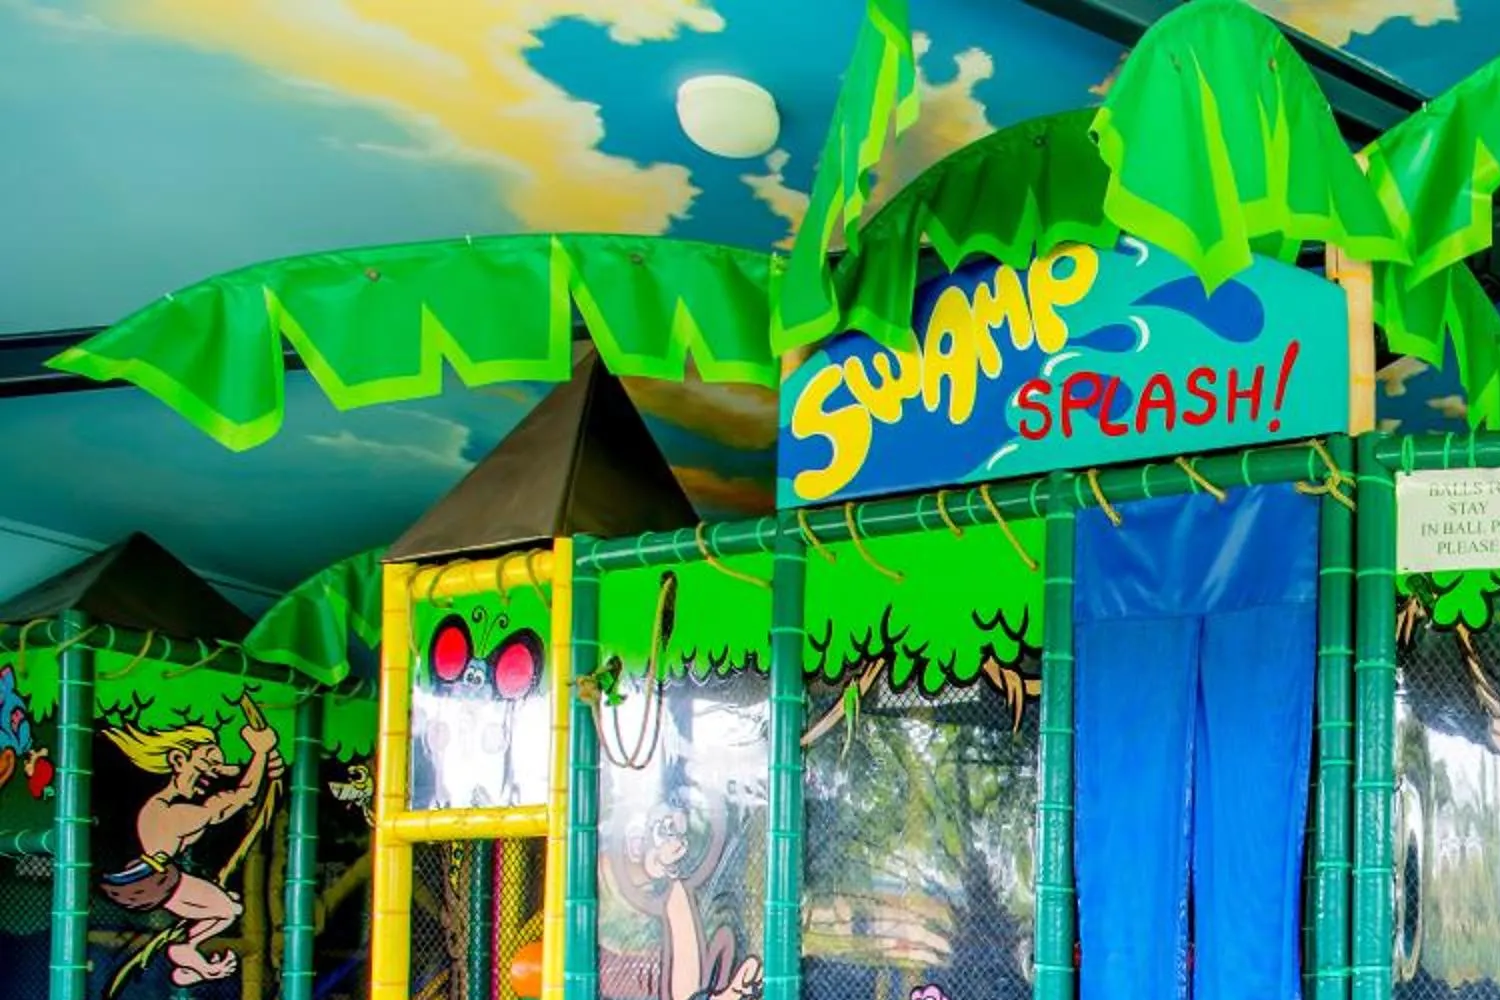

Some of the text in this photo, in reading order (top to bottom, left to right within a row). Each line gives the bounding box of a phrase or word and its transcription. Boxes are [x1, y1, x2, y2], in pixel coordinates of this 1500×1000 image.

[791, 242, 1099, 501] SWAMP
[1017, 339, 1300, 440] SPLASH!
[1429, 481, 1482, 497] BALLS
[1448, 501, 1488, 516] STAY
[1421, 523, 1438, 537] IN
[1443, 521, 1484, 535] BALL
[1437, 540, 1500, 555] PLEASE
